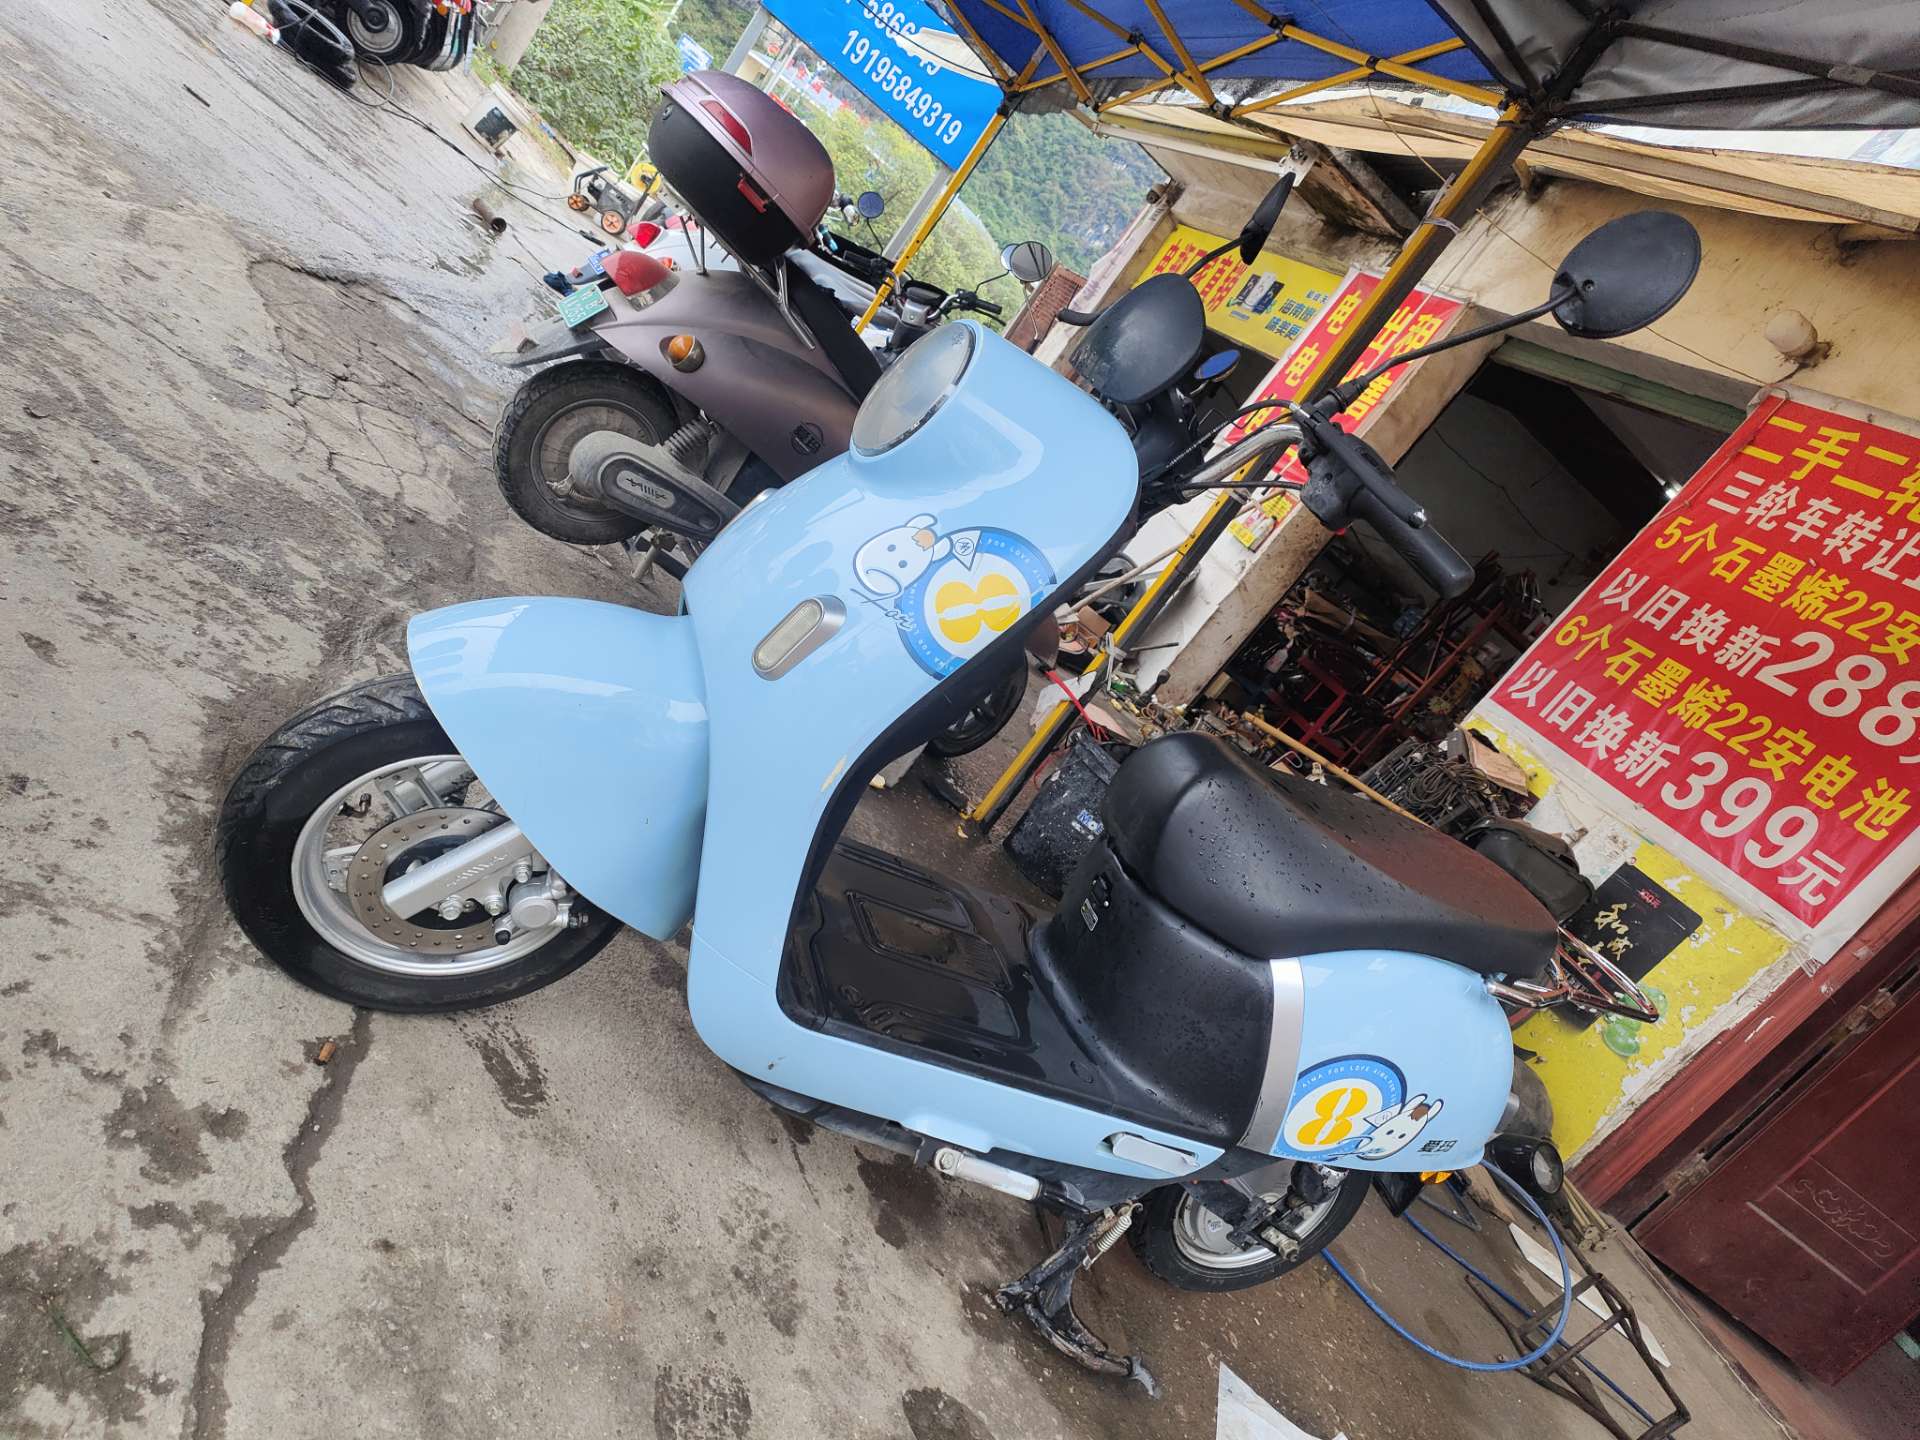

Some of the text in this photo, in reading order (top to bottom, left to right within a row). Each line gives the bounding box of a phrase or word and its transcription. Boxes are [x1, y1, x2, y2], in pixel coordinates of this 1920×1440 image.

[841, 30, 963, 144] 19195849319
[1655, 516, 1920, 665] 5个石墨烯22安
[1708, 470, 1920, 591] 三轮车转让
[1554, 615, 1911, 840] 6个石墨烯22安电池
[1598, 567, 1920, 764] 以旧换新288
[1508, 660, 1848, 906] 以旧换新399元
